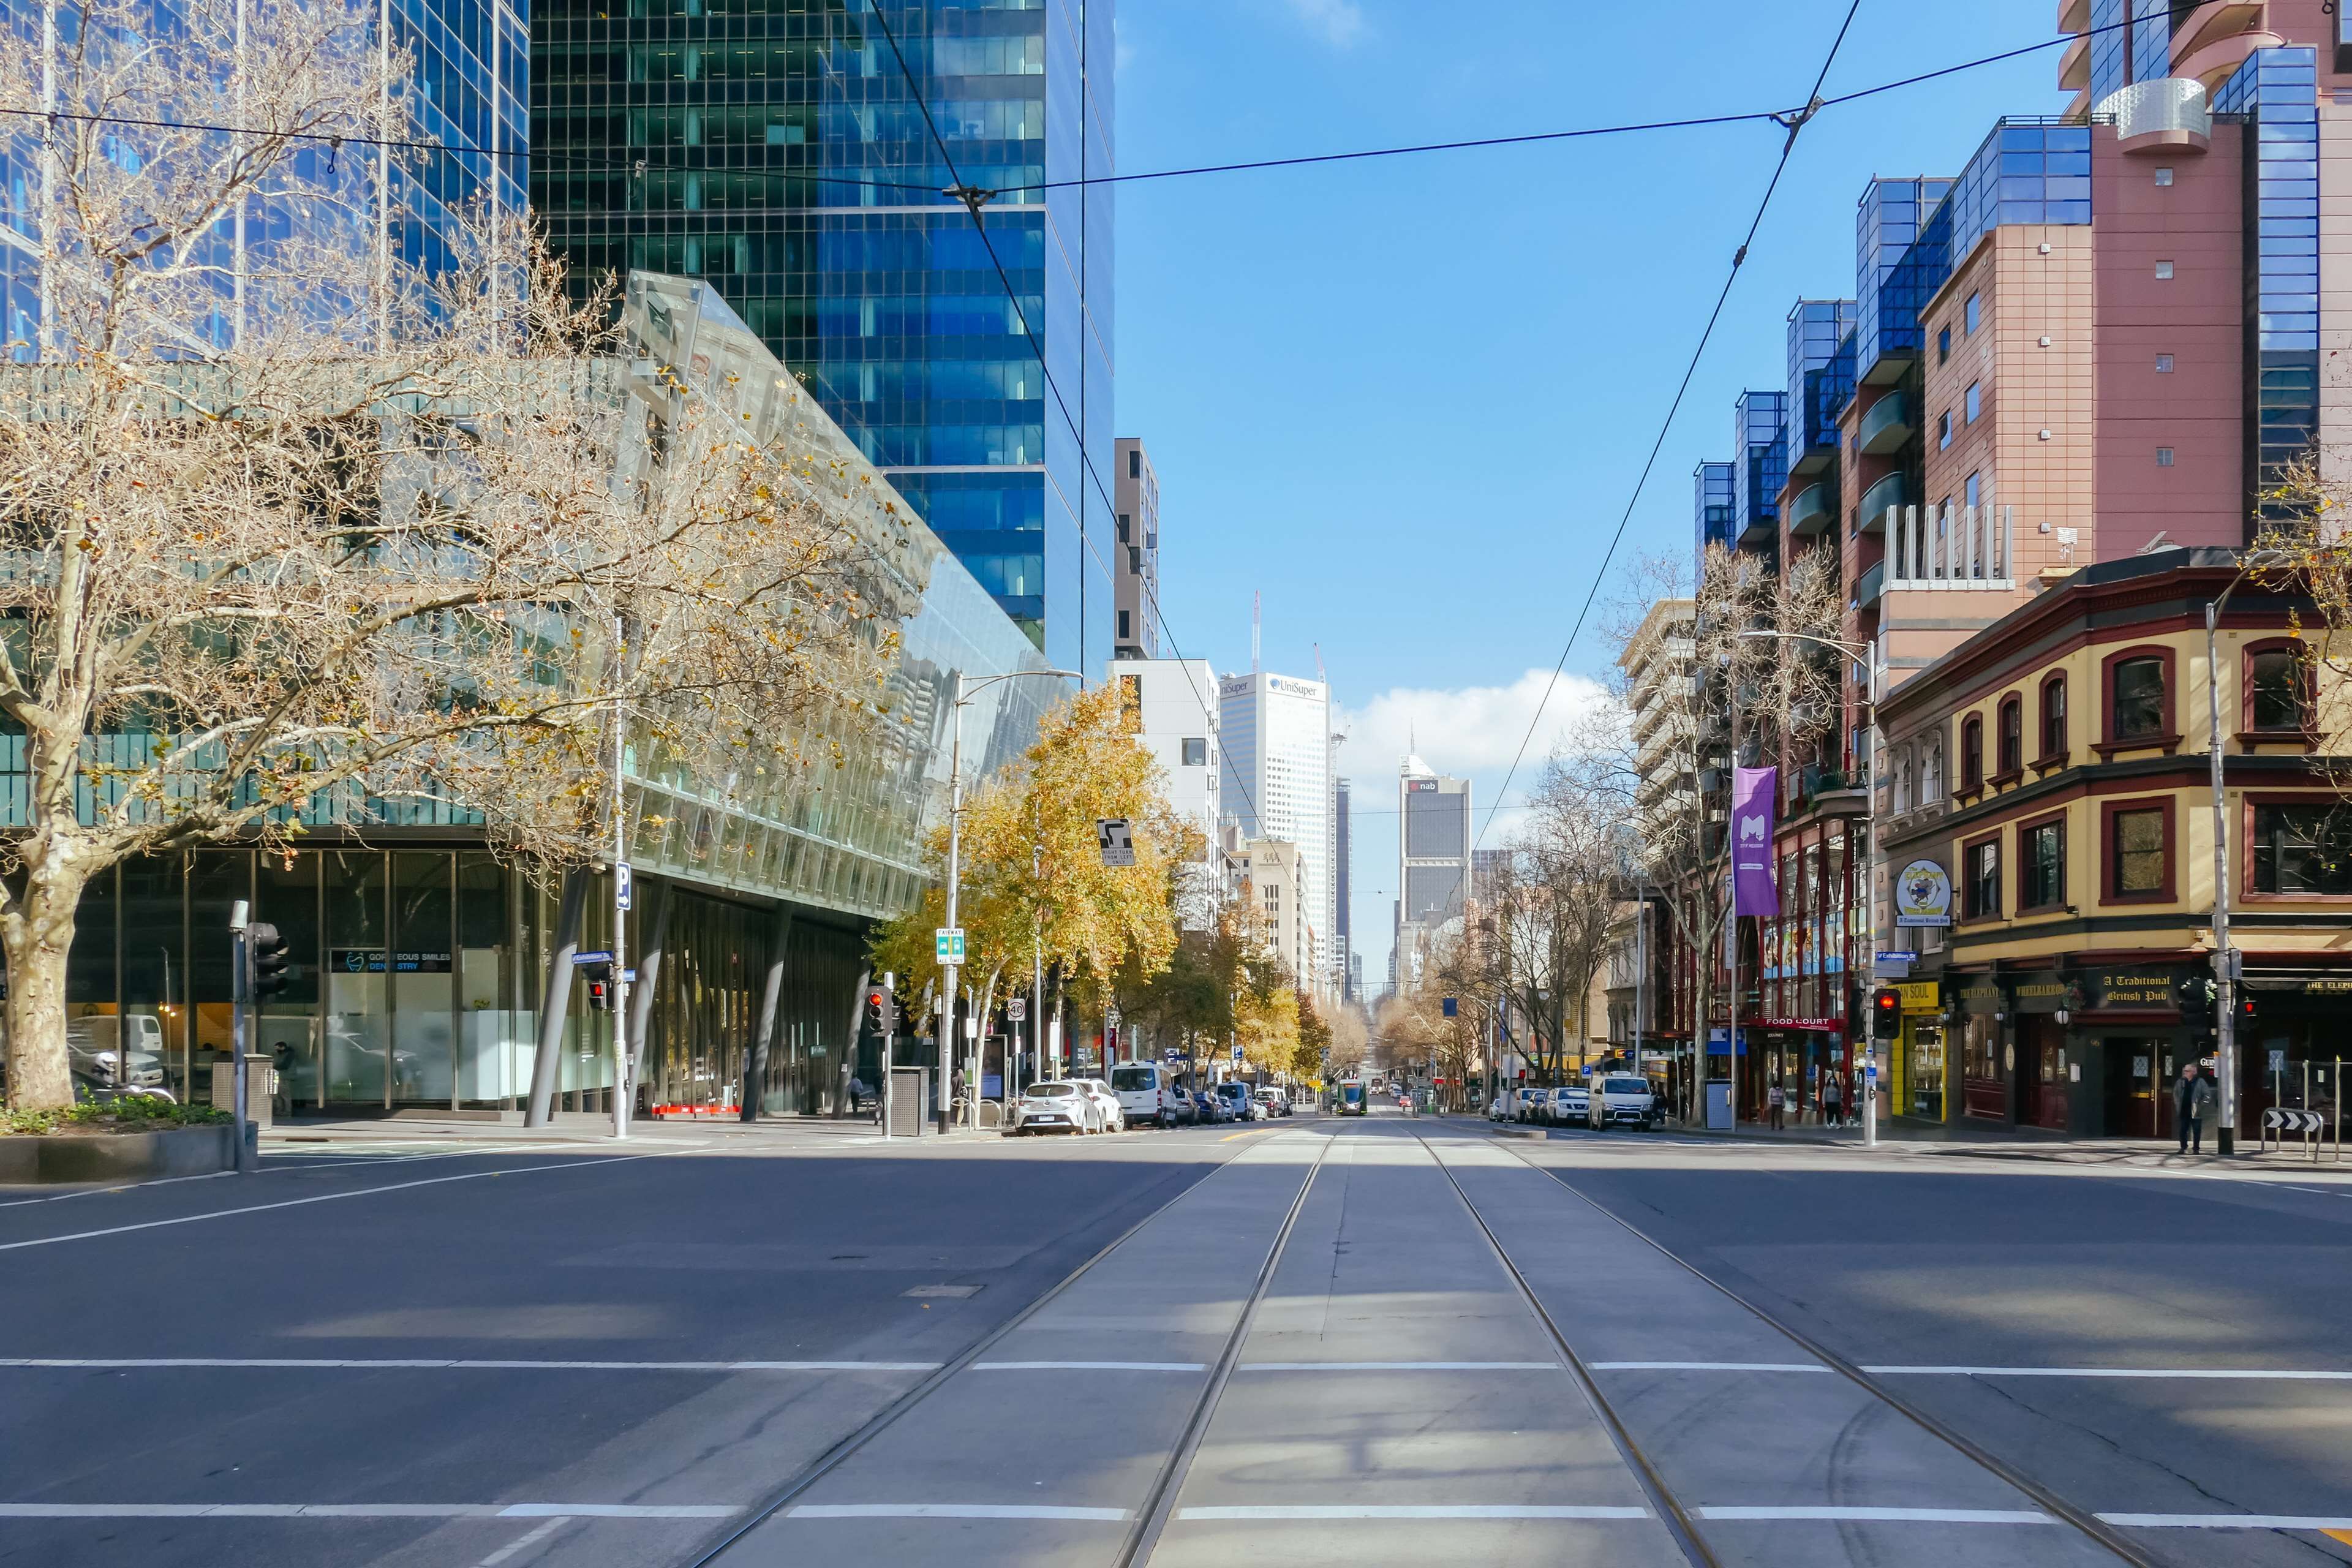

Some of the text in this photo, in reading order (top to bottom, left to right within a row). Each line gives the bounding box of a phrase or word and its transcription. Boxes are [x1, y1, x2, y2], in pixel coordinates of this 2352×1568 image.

[1280, 680, 1317, 697] UniSuper
[618, 866, 628, 894] P
[2103, 976, 2170, 986] A Traditional
[1910, 984, 1929, 999] SOUL
[1970, 987, 1999, 998] ELEPHANT
[2107, 990, 2167, 1002] British Pub
